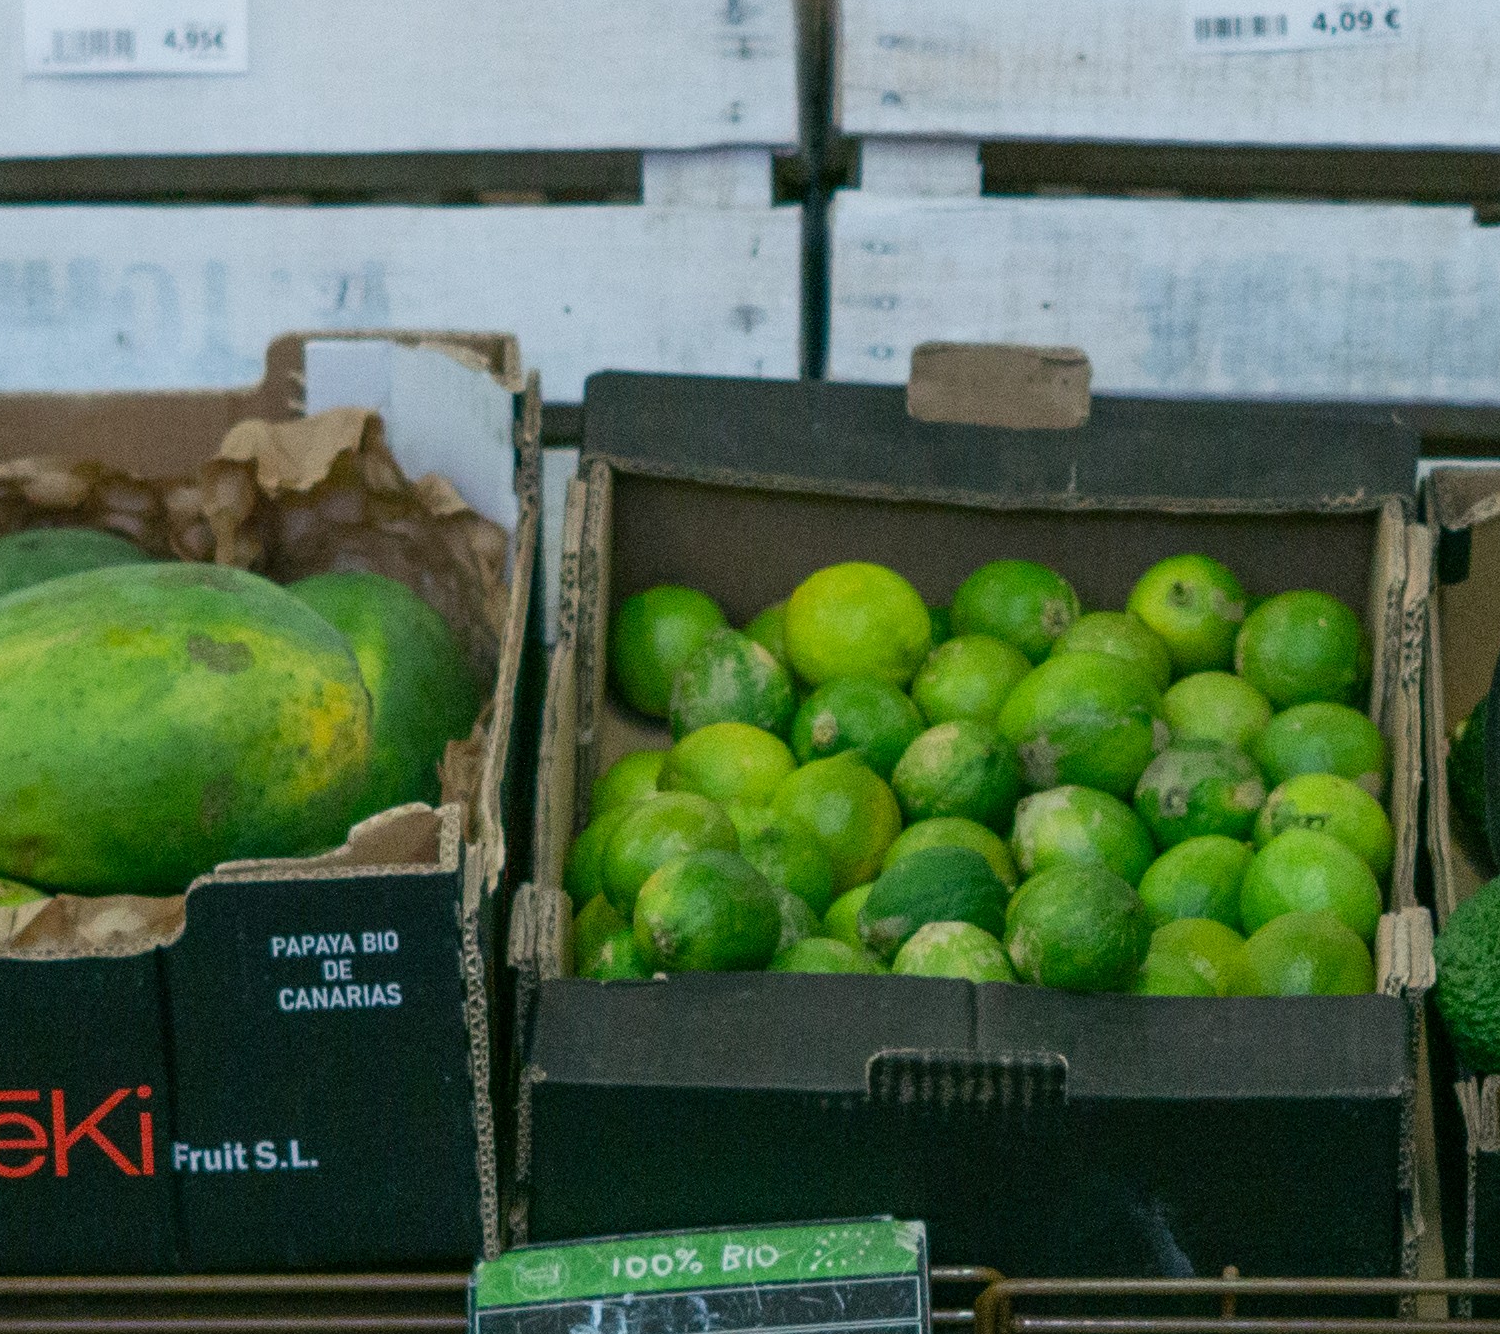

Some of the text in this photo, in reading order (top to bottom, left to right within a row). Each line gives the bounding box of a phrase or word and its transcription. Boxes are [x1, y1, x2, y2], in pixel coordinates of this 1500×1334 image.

[1312, 7, 1401, 36] 4,09 €
[271, 929, 400, 958] PAPAYA BIO
[322, 959, 353, 981] DE
[278, 982, 403, 1012] CANARIAS
[172, 1139, 320, 1173] Fruit S.L.
[612, 1243, 780, 1280] 100% BIO
